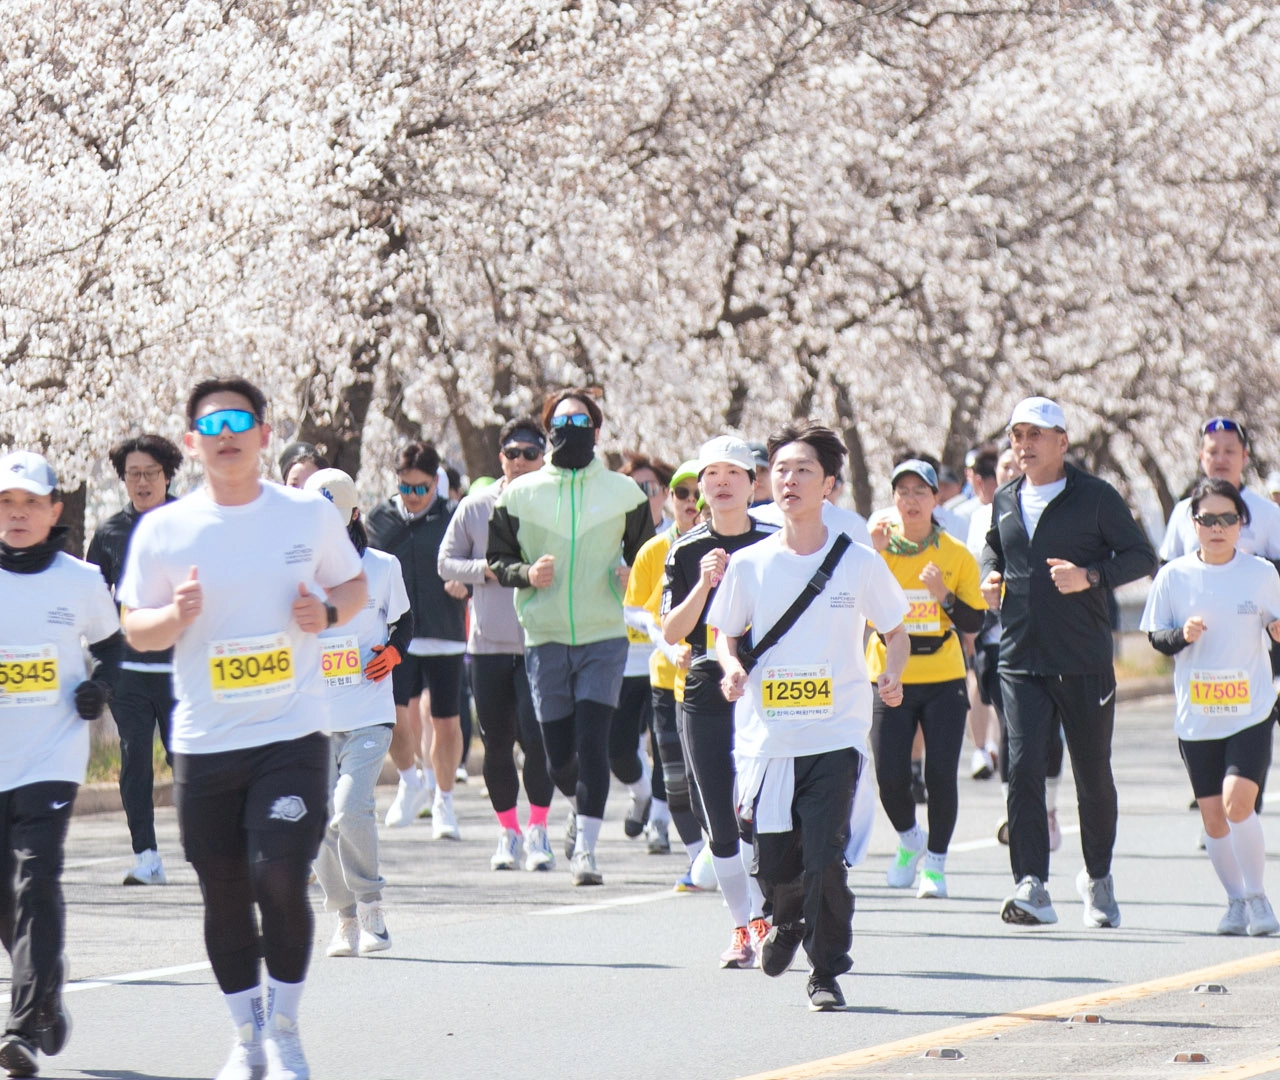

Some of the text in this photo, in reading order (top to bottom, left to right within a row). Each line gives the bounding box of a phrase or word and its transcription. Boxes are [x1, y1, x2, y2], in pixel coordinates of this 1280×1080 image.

[906, 602, 937, 619] 224
[213, 650, 290, 681] 13046
[322, 650, 359, 671] 676
[765, 680, 831, 701] 12594
[1193, 681, 1248, 700] 17505
